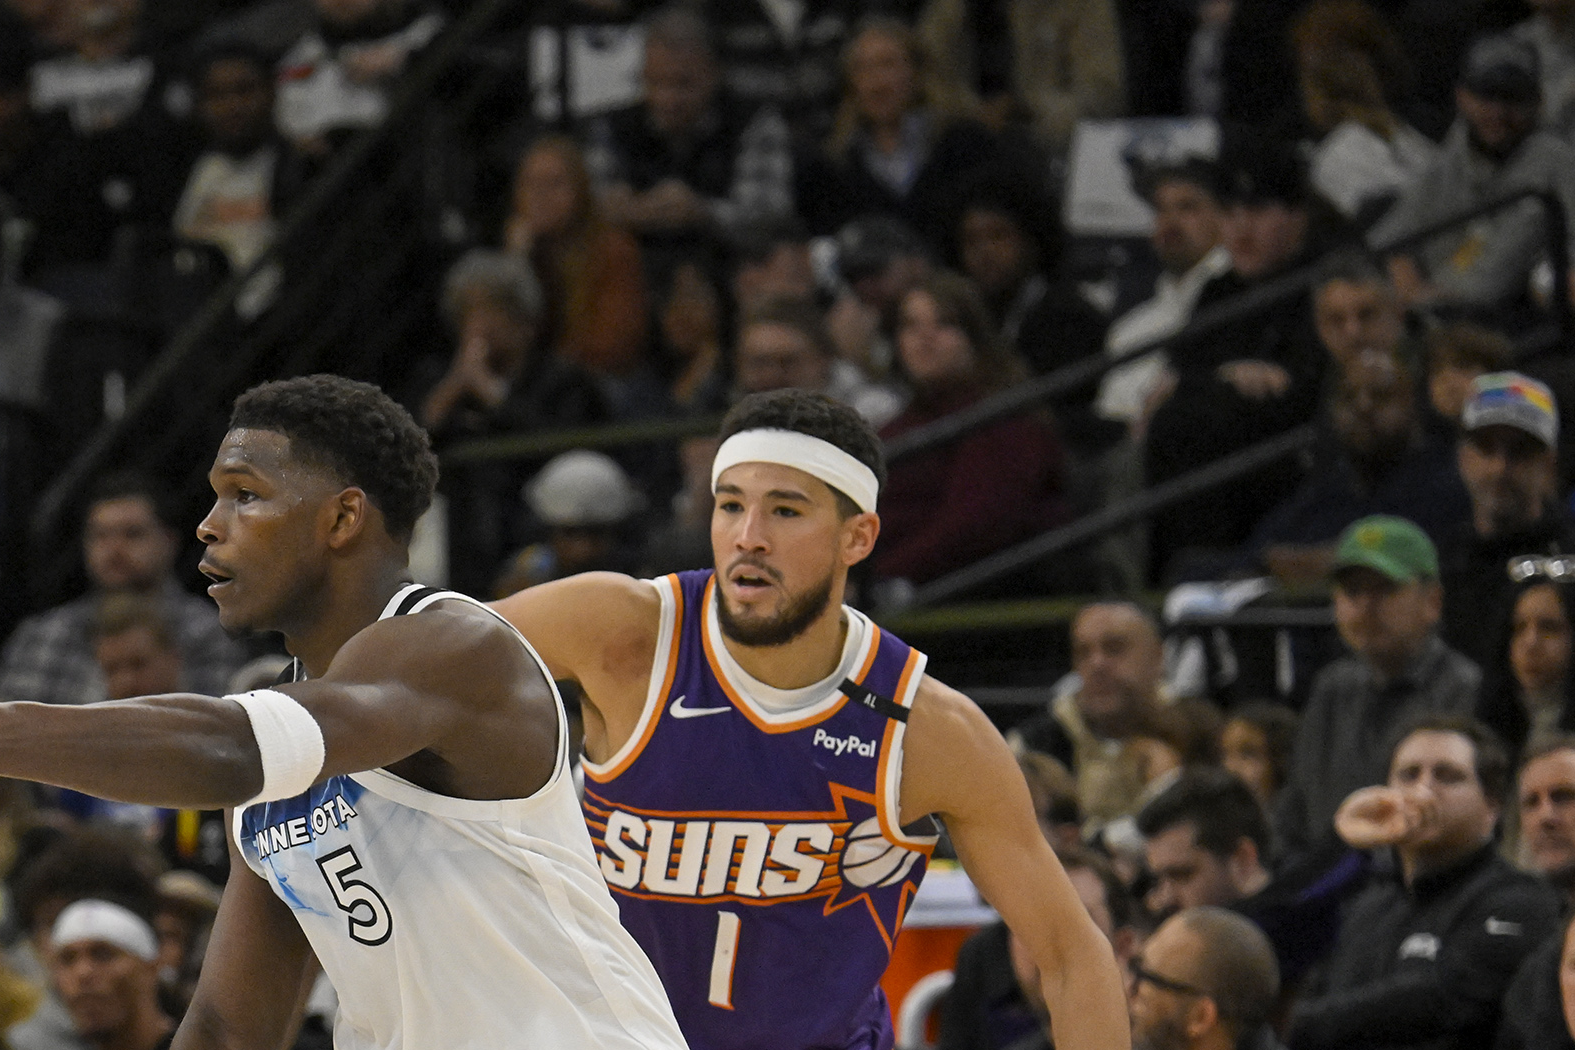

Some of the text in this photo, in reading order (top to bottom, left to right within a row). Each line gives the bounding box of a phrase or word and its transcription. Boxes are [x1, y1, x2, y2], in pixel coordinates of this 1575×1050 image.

[812, 728, 877, 758] PayPal
[863, 692, 877, 709] AL
[315, 844, 393, 947] 5
[600, 809, 835, 897] SUNS
[708, 910, 742, 1011] 1
